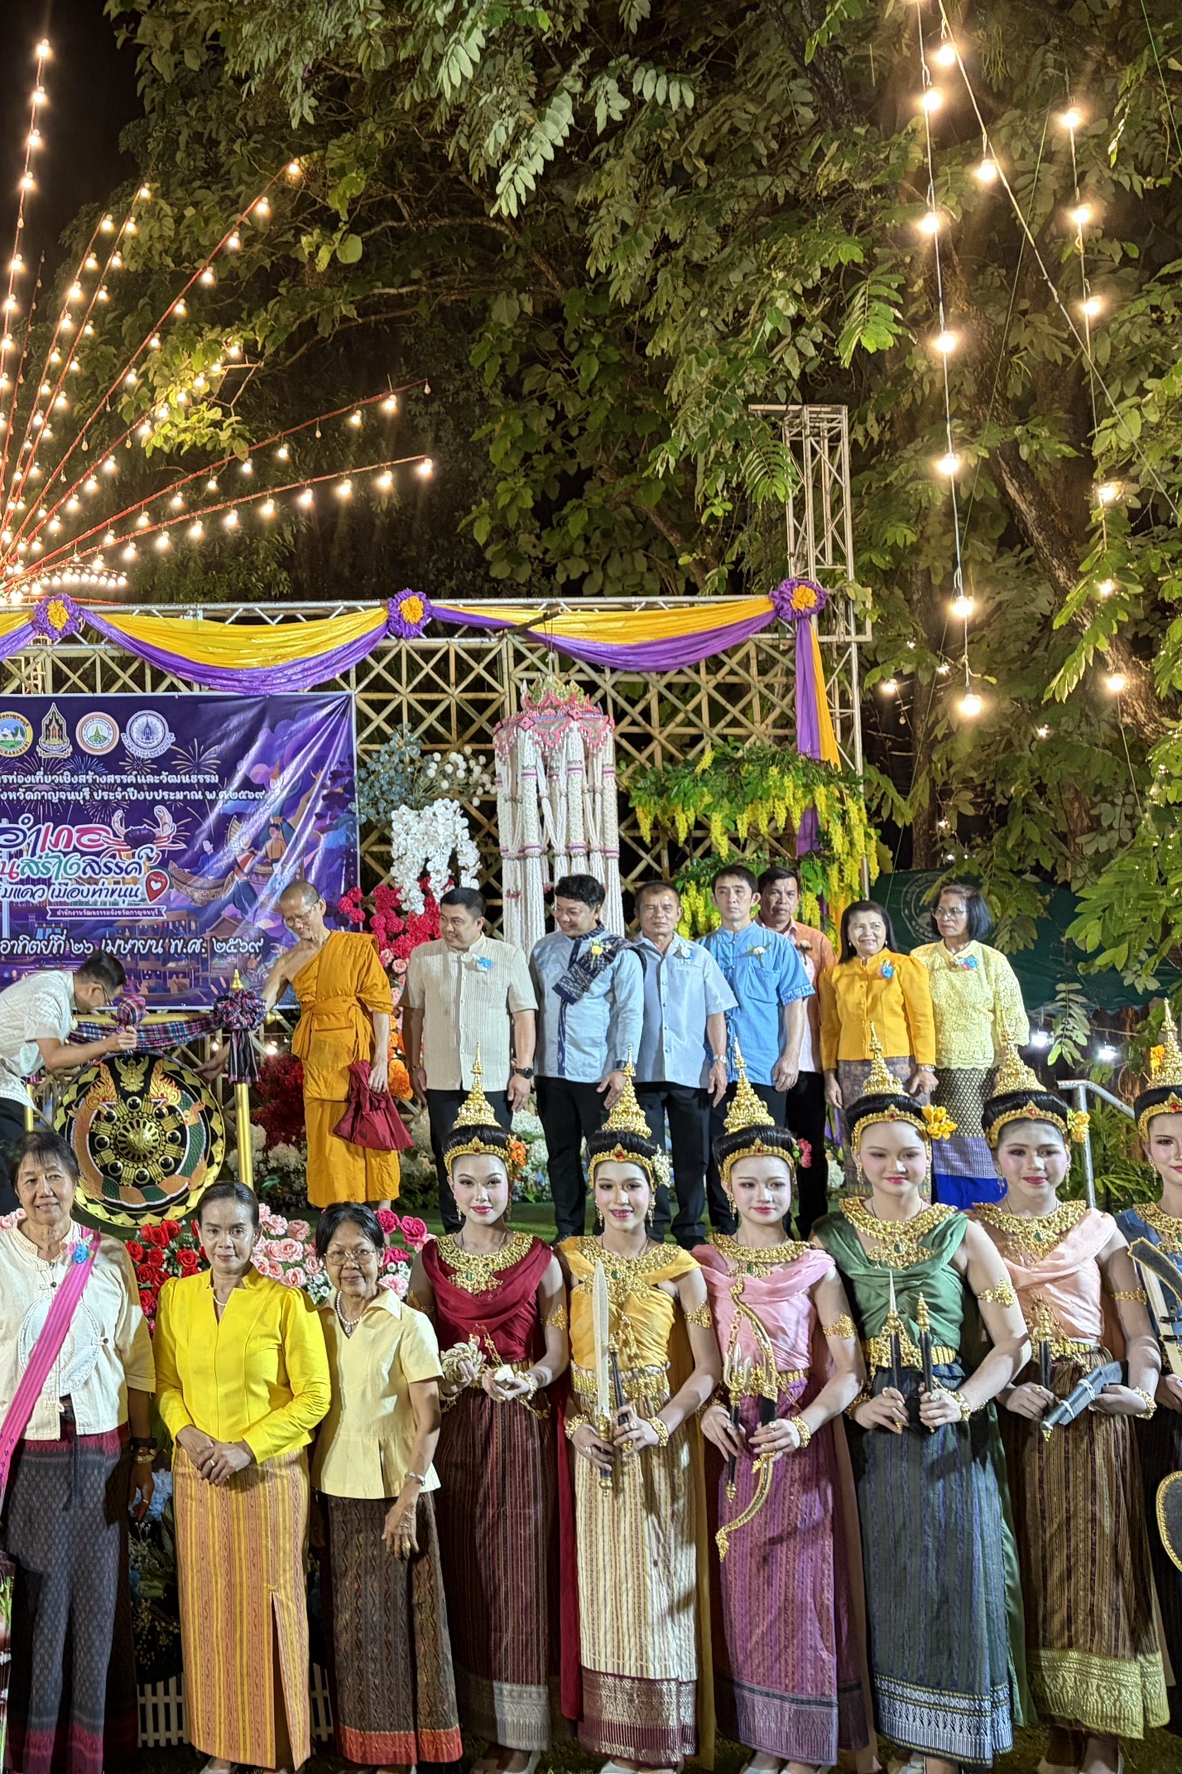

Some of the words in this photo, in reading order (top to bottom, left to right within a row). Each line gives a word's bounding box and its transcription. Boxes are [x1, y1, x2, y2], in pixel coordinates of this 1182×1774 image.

[94, 788, 203, 800] ประจำปีงบประมาณ
[50, 880, 141, 904] เมืองท่าขนุน
[70, 939, 94, 954] ๒๖
[102, 937, 163, 954] เมษายน
[170, 938, 206, 954] พ.ศ.
[212, 938, 264, 954] ๒๕๖๙
